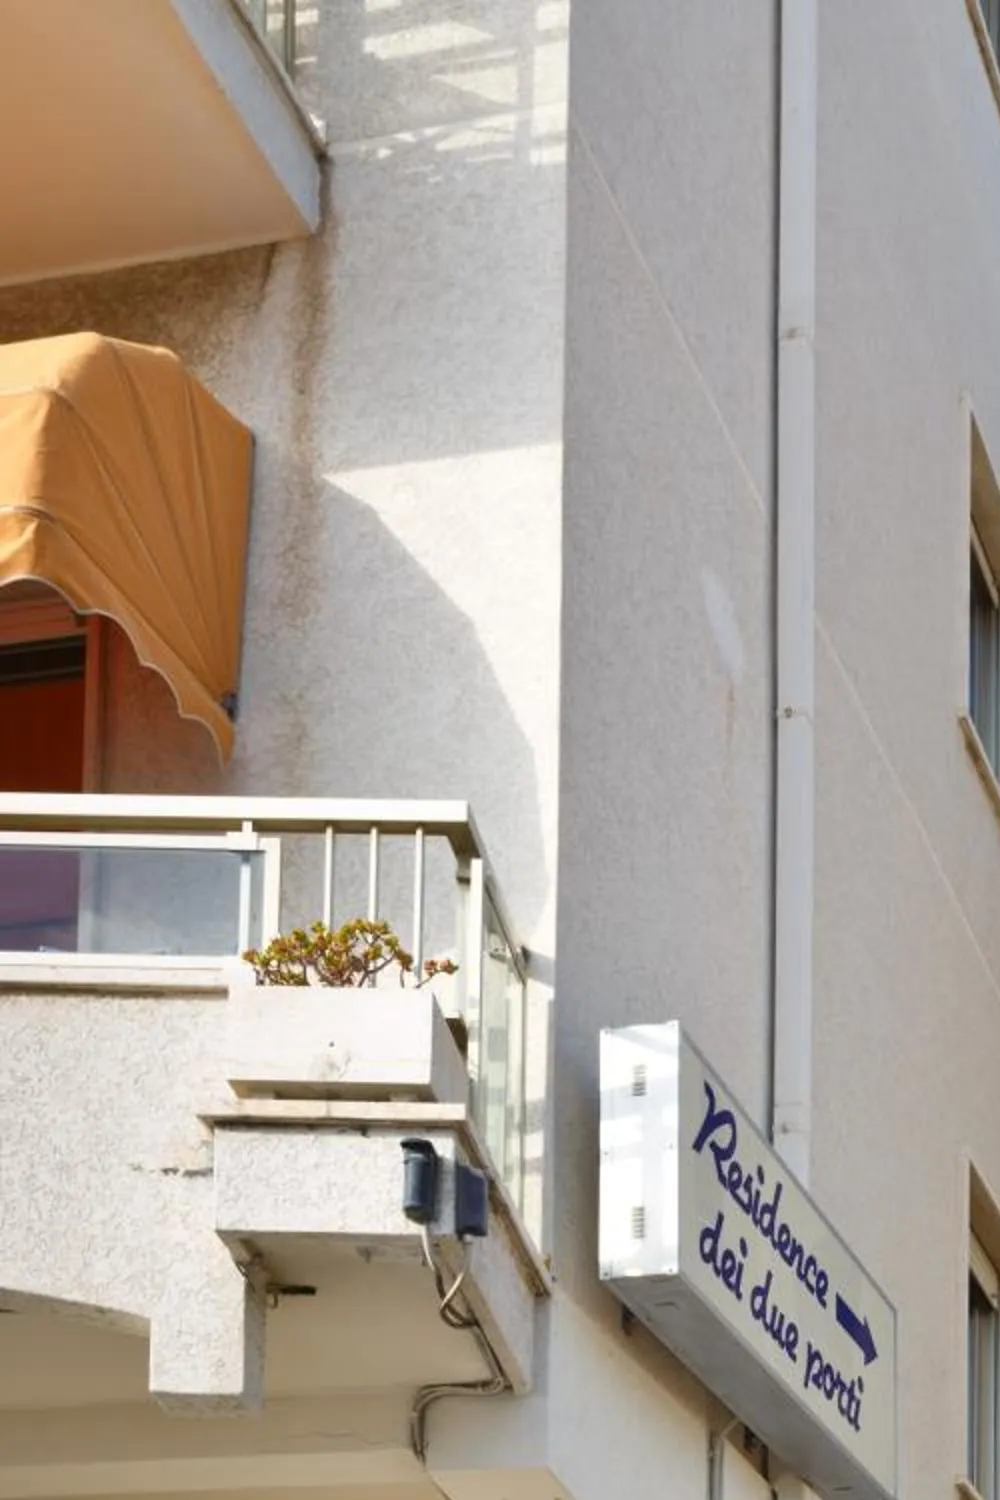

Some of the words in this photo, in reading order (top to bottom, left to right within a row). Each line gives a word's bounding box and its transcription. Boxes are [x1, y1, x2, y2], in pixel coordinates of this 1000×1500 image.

[692, 1080, 829, 1309] Residence
[700, 1210, 748, 1301] dei
[750, 1269, 799, 1363] due
[804, 1340, 865, 1433] porti
